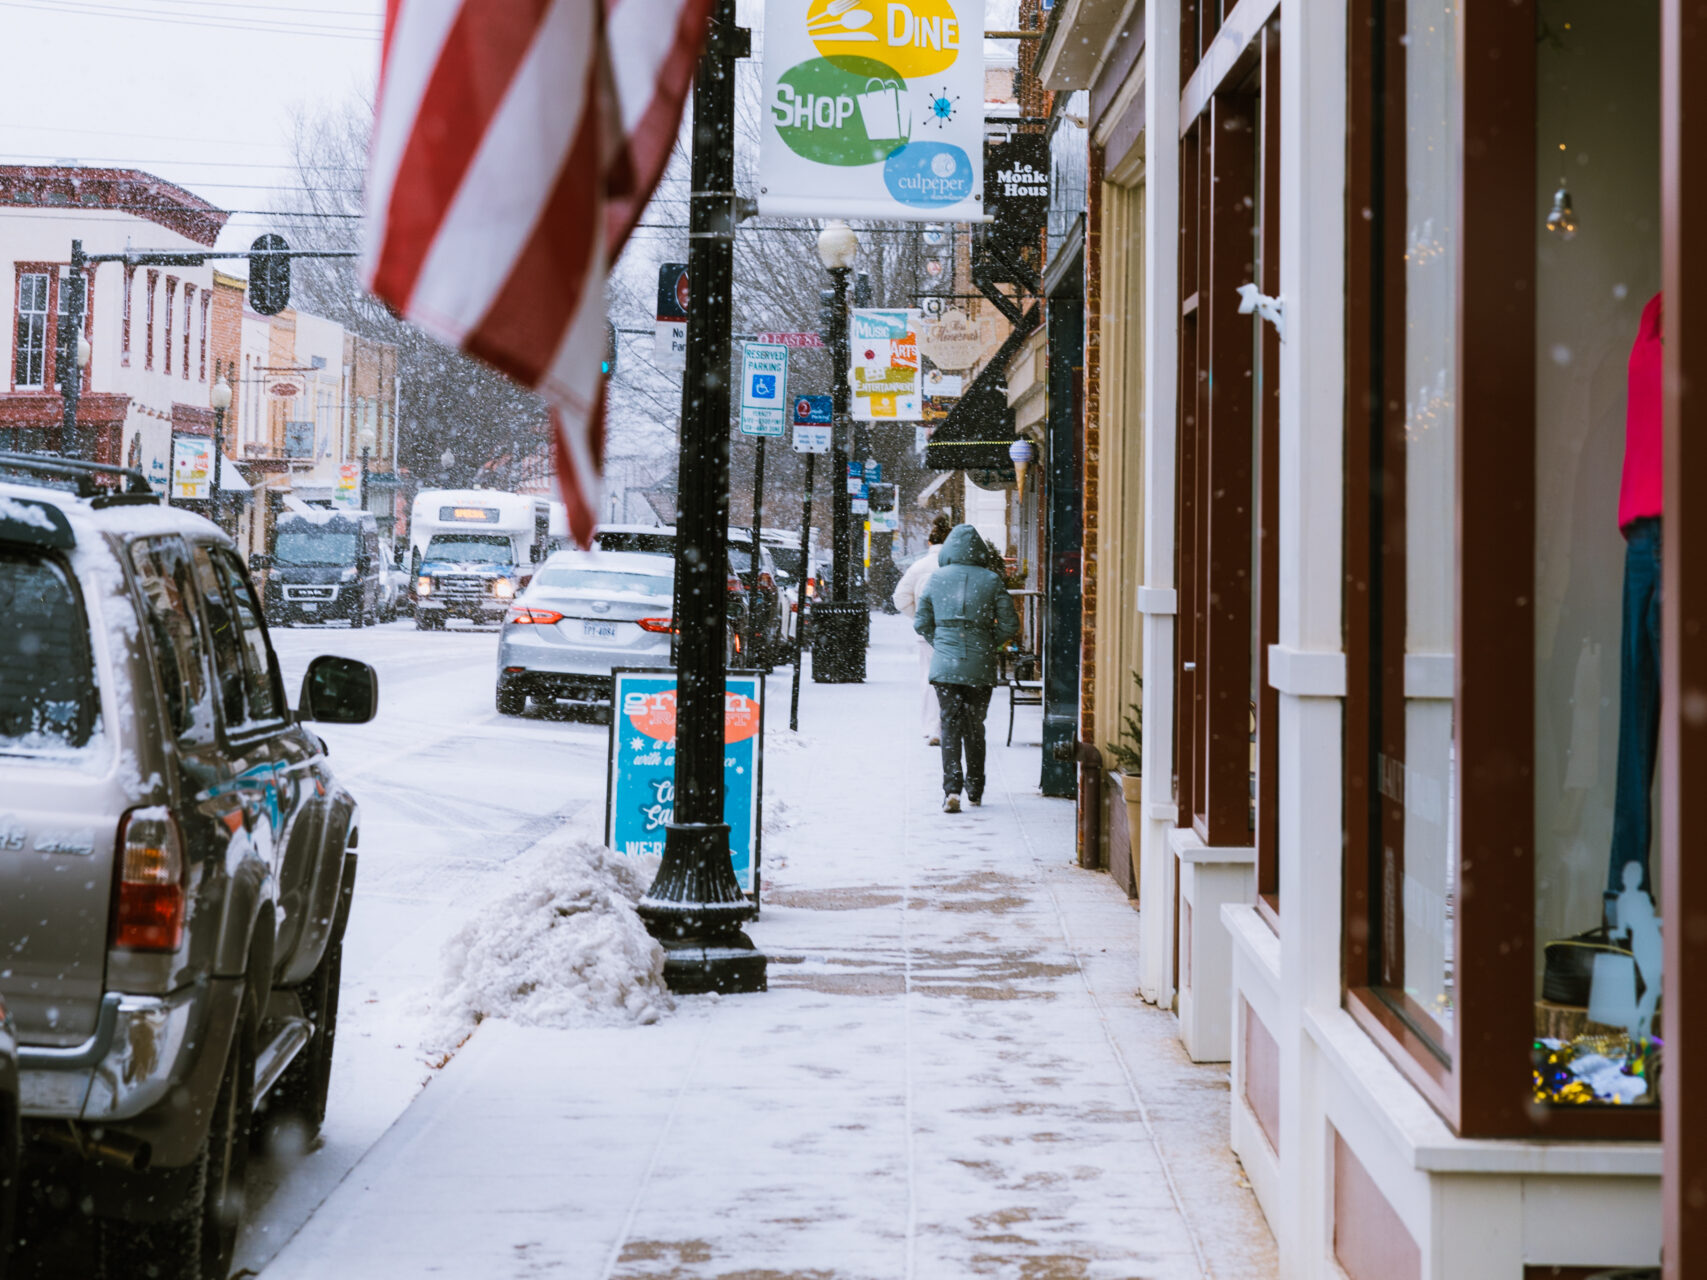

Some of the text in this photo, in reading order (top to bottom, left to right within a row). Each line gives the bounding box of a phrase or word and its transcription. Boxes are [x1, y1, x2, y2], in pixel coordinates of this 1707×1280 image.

[887, 3, 960, 51] DINE
[771, 83, 855, 131] SHOP
[1013, 161, 1033, 173] Le
[898, 173, 965, 193] culpeper
[1004, 184, 1049, 197] Hous
[672, 328, 684, 338] No
[746, 350, 785, 361] RESERVED
[748, 362, 782, 372] PARKING
[623, 692, 751, 715] grn
[633, 752, 662, 766] with
[625, 841, 666, 858] WE'R
